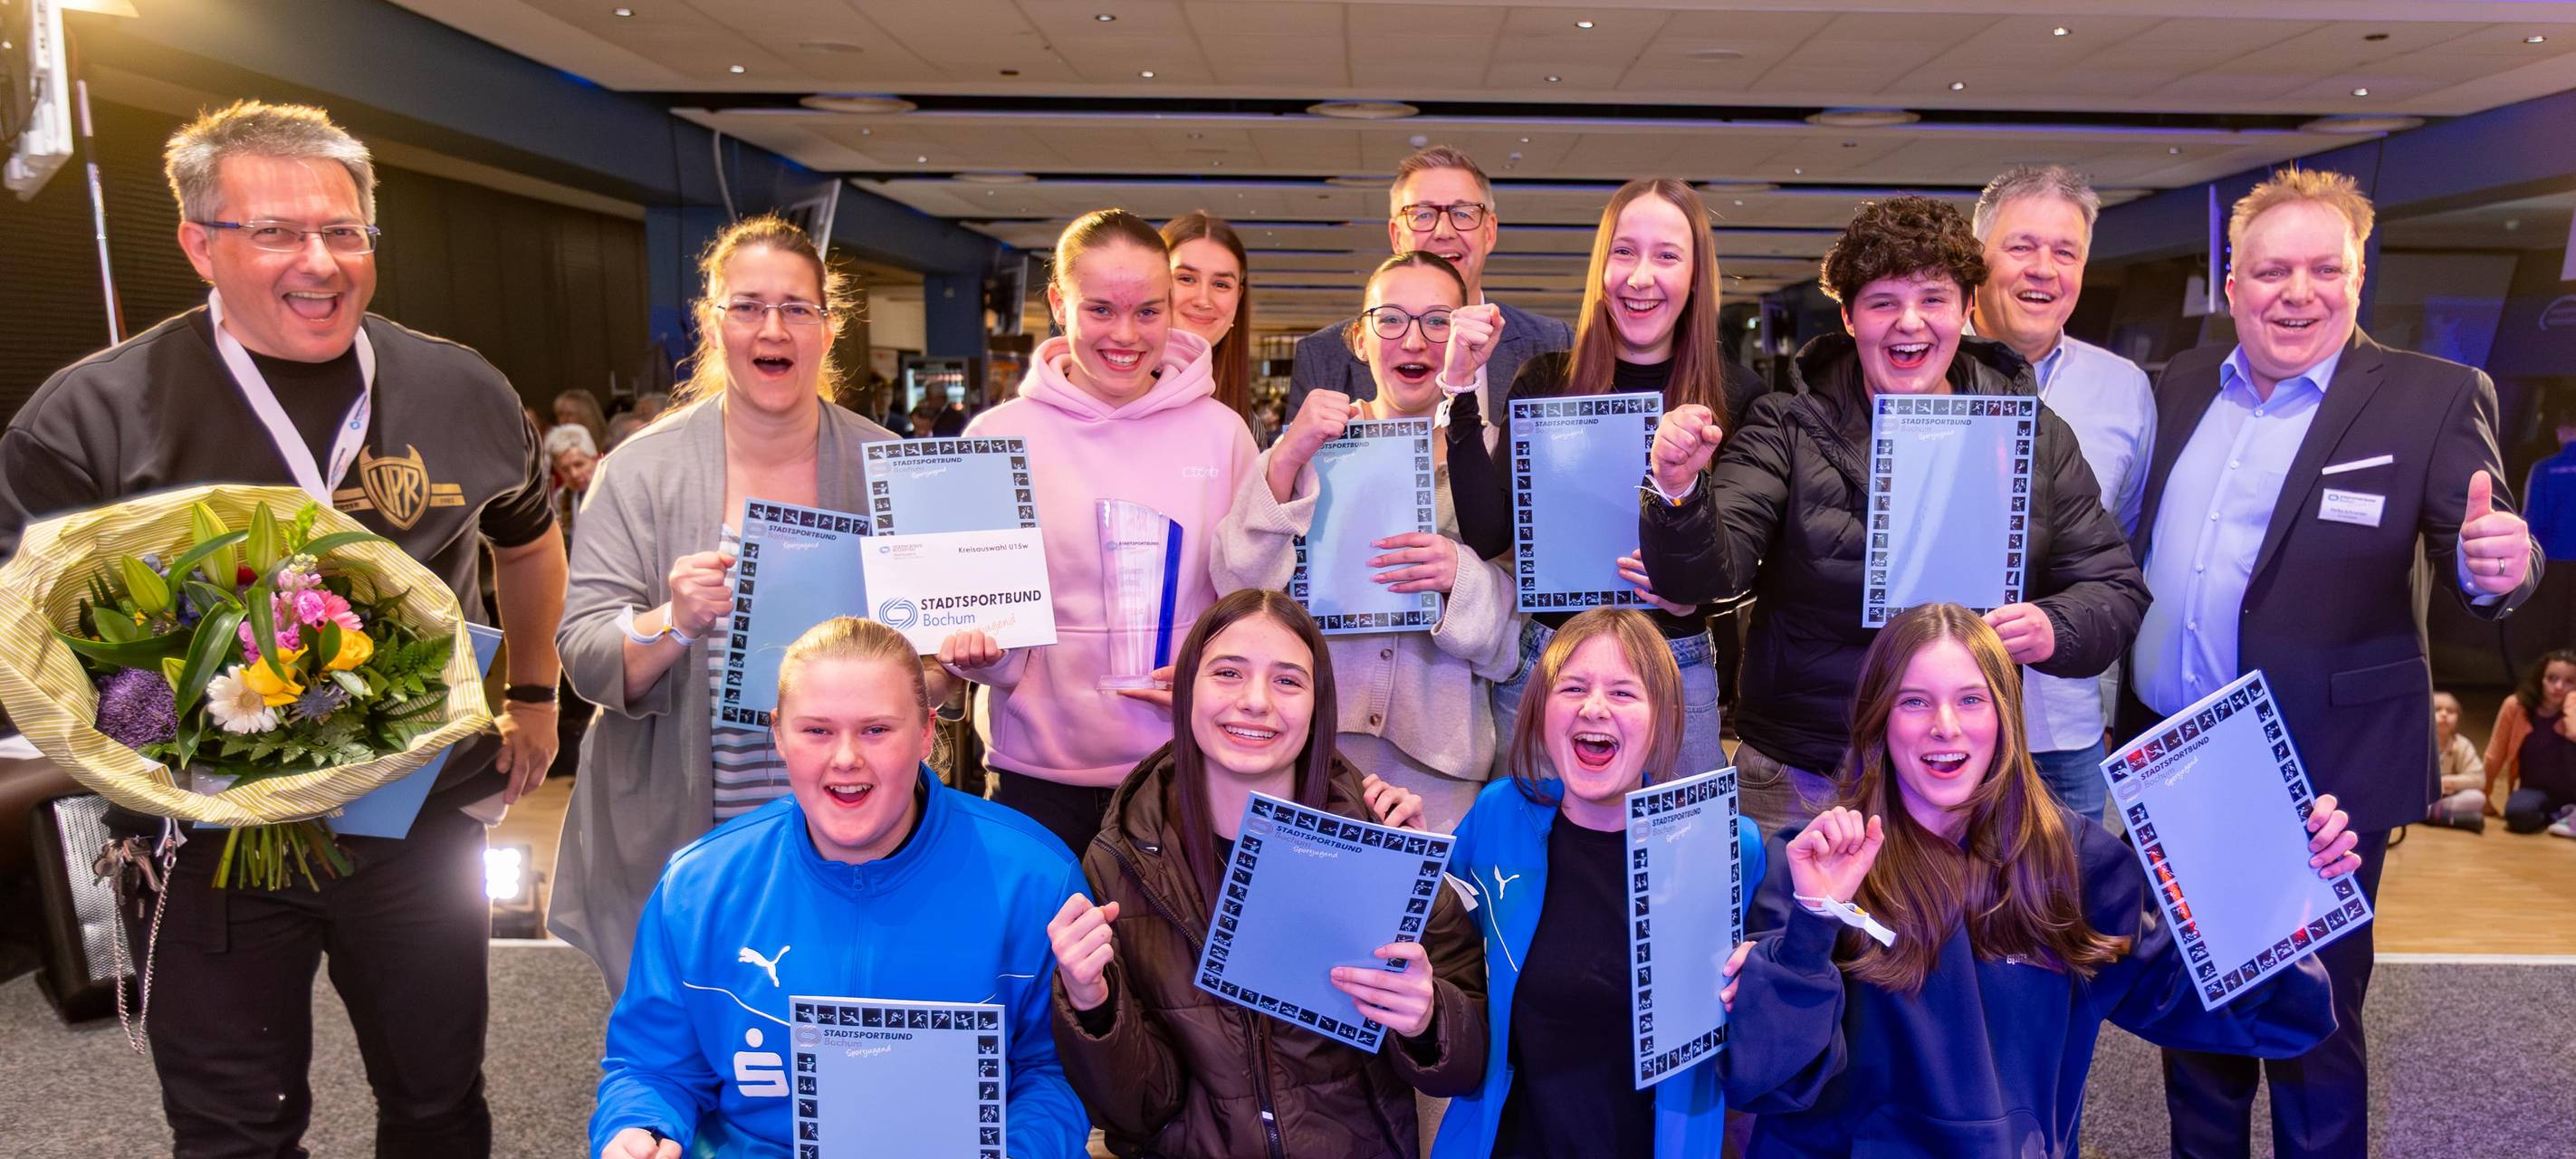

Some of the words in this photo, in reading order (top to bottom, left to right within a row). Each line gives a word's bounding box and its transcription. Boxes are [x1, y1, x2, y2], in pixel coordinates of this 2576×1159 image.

[1535, 418, 1599, 427] STADTSPORTBUND
[1901, 417, 1972, 426] STADTSPORTBUND
[1322, 441, 1370, 450] TSPORTBUND
[893, 456, 962, 466] STADTSPORTBUND
[769, 524, 838, 541] STADTSPORTBUND
[958, 544, 1008, 553] Kreisauswahl
[1009, 542, 1029, 551] U15w
[920, 589, 1042, 611] STADTSPORTBUND
[923, 612, 976, 627] Bochum
[2140, 736, 2210, 781] STADTSPORTBUND
[1652, 807, 1702, 827] STADTSPORTBUND
[1276, 825, 1363, 853] STADTSPORTBUND
[824, 1029, 913, 1040] STADTSPORTBUND
[824, 1038, 863, 1048] Bochum
